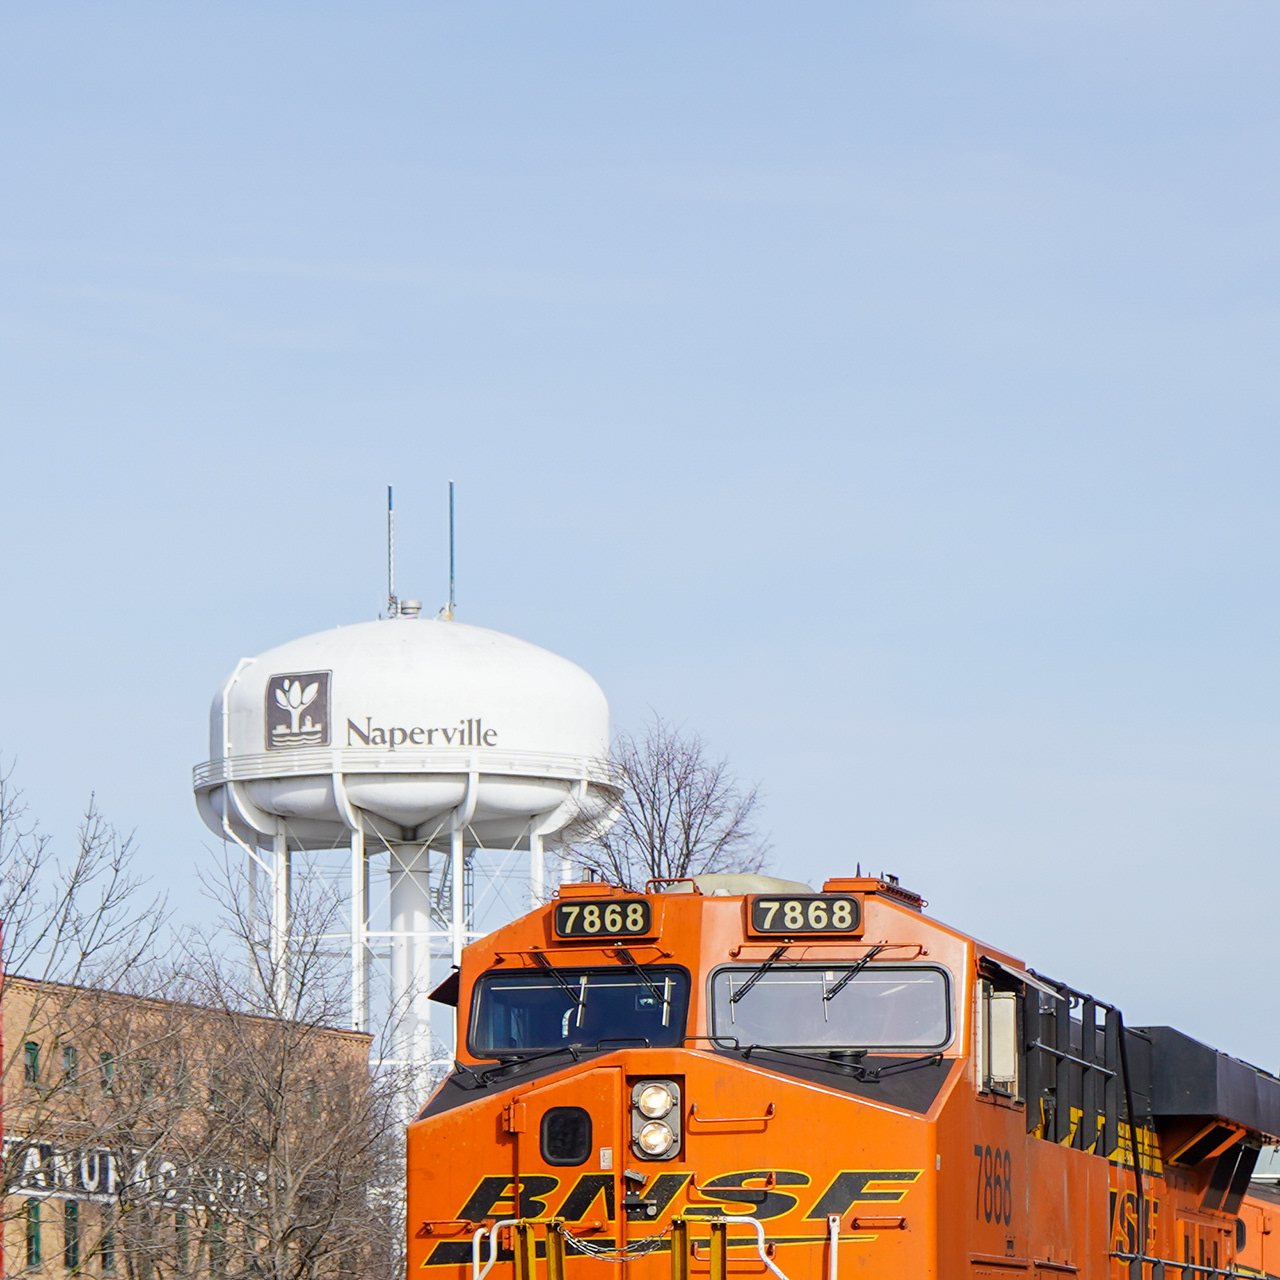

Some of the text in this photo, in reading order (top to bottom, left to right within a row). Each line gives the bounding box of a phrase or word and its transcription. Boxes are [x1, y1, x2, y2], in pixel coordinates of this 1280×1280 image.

[346, 717, 498, 752] Naperville
[562, 903, 644, 934] 7868
[760, 900, 852, 930] 7868
[453, 1168, 925, 1224] BNSF
[974, 1144, 1011, 1227] 7868
